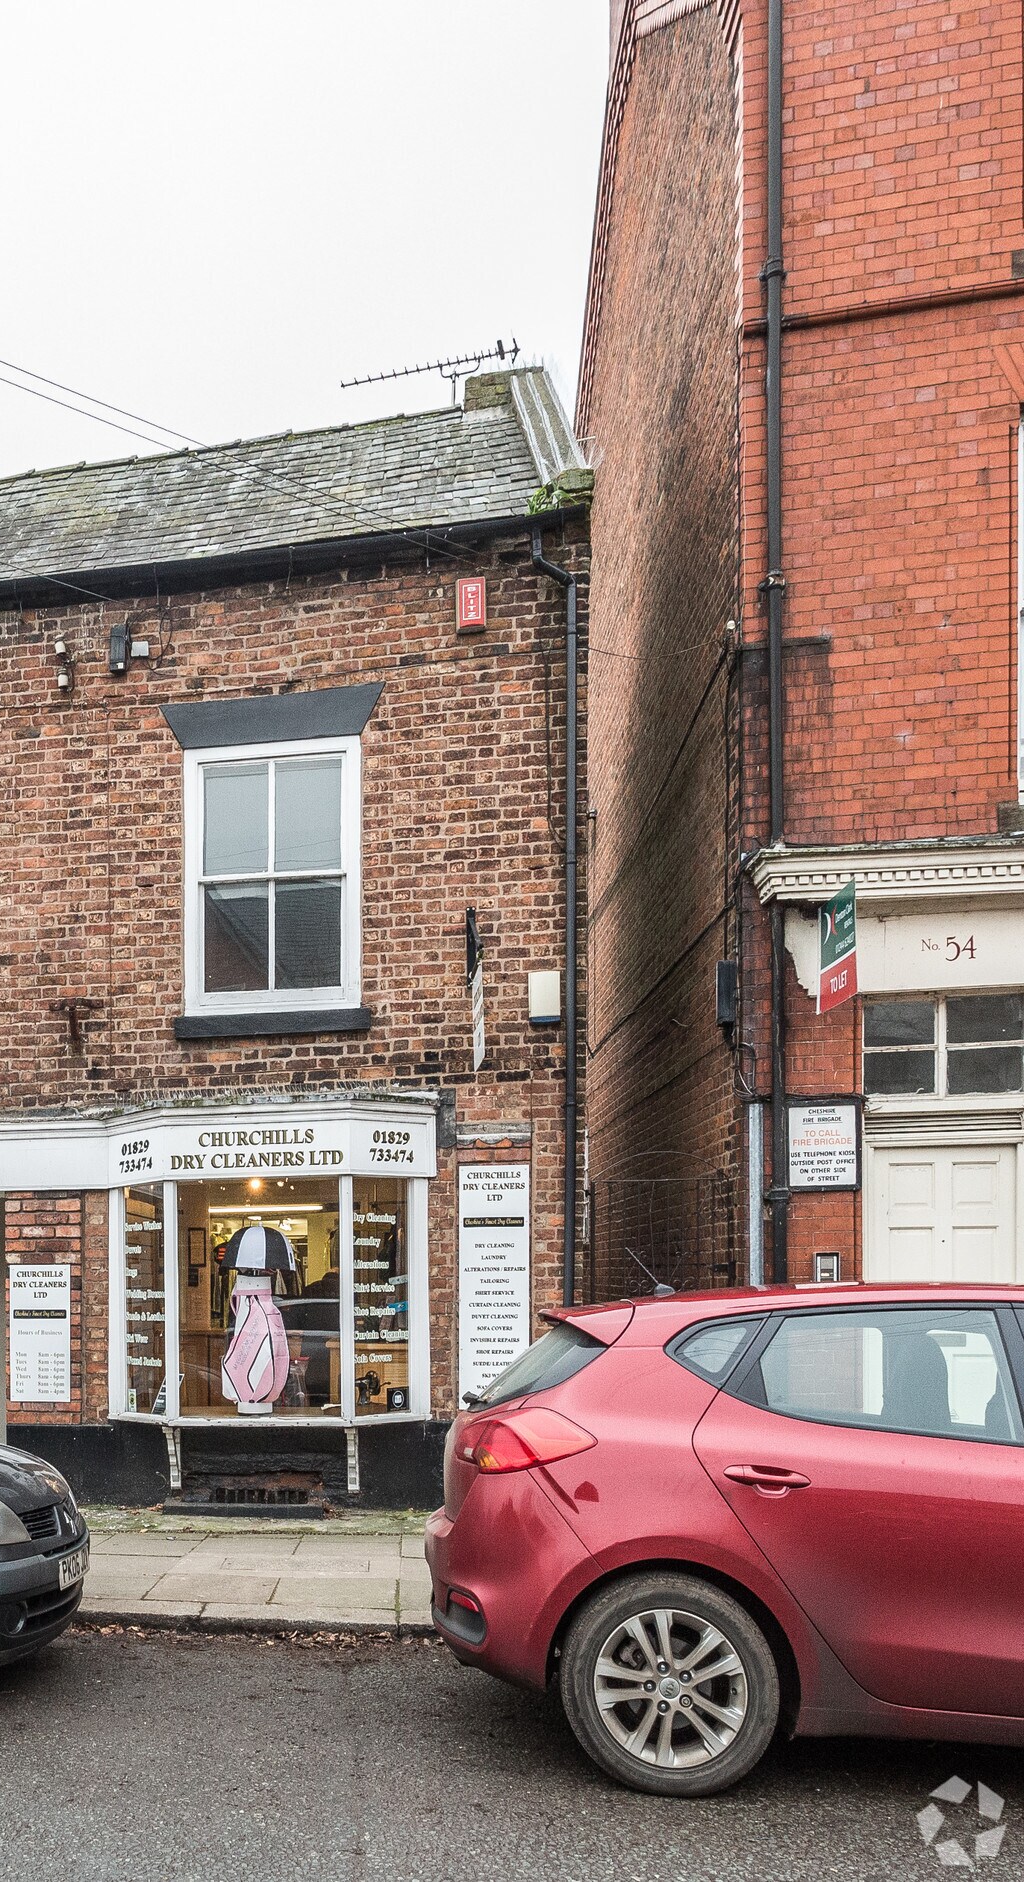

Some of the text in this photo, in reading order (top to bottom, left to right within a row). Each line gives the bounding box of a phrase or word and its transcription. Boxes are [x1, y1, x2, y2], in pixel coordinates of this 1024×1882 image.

[467, 586, 476, 618] BLITZ
[921, 935, 977, 962] No. 54
[830, 970, 848, 994] TO LET
[198, 1128, 314, 1147] CHURCHILLS
[372, 1130, 410, 1145] 01829
[818, 1129, 840, 1137] CALL
[814, 1137, 852, 1145] BRIGADE
[121, 1140, 150, 1156] 01829
[170, 1149, 344, 1170] DRY CLEANERS LTD
[369, 1148, 414, 1163] 733474
[119, 1157, 153, 1174] 733474
[467, 1171, 521, 1179] CHURCHILLS
[482, 1182, 526, 1190] CLEANERS
[353, 1213, 396, 1225] Dry Cleaning
[353, 1283, 395, 1293] Shirt Service
[354, 1307, 396, 1317] Shoe Repairs
[354, 1329, 409, 1340] Curtain Cleaning
[354, 1353, 393, 1364] Sofa Covers
